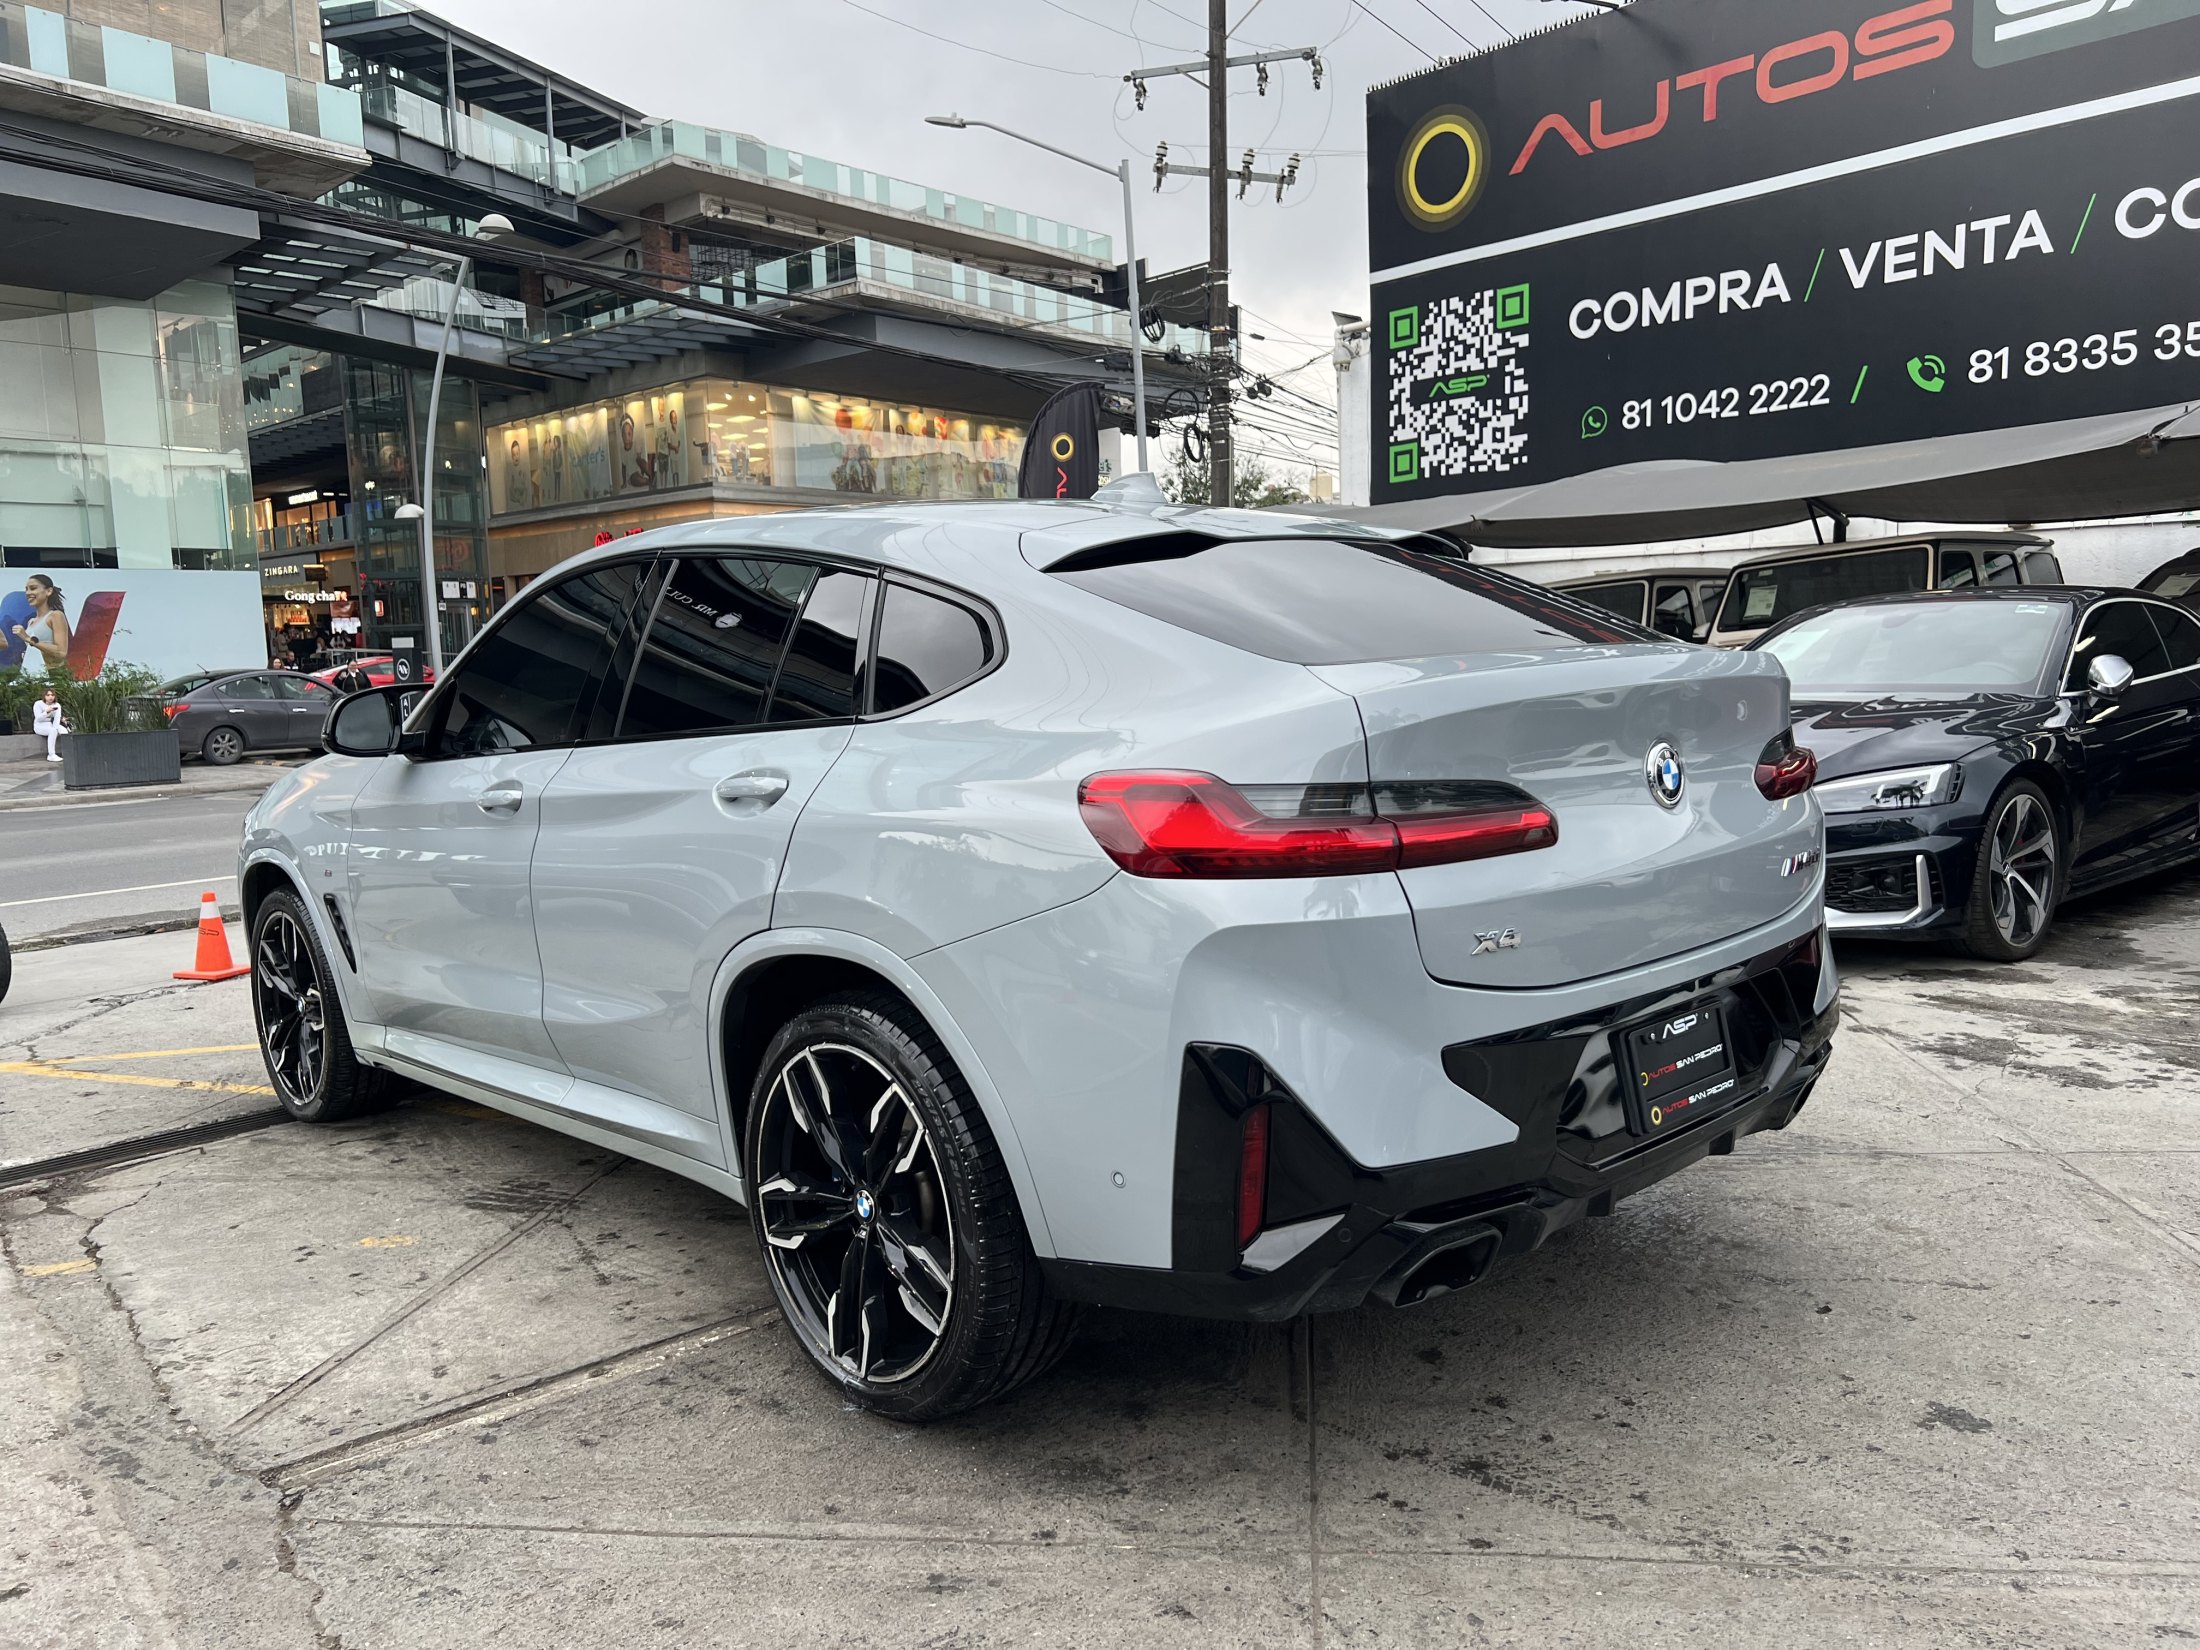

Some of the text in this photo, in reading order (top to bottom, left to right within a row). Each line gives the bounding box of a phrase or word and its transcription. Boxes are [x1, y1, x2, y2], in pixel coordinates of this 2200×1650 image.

[1509, 0, 1955, 176] AUTOS
[1568, 262, 1792, 340] COMPRA
[1838, 209, 2054, 289] VENTA
[1429, 374, 1488, 398] ASP
[1621, 398, 1652, 430] 81
[1661, 386, 1739, 425] 1042
[1749, 373, 1831, 415] 2222
[1967, 346, 2010, 383] 81
[2023, 328, 2138, 377] 8335
[264, 565, 299, 577] ZINGARA
[284, 590, 316, 603] Gong
[1471, 927, 1521, 956] X4
[1663, 1013, 1698, 1039] ASP
[1648, 1043, 1723, 1081] AUTOS SAN PEDRO
[1662, 1079, 1734, 1115] AUTOS SAN PEDRO
